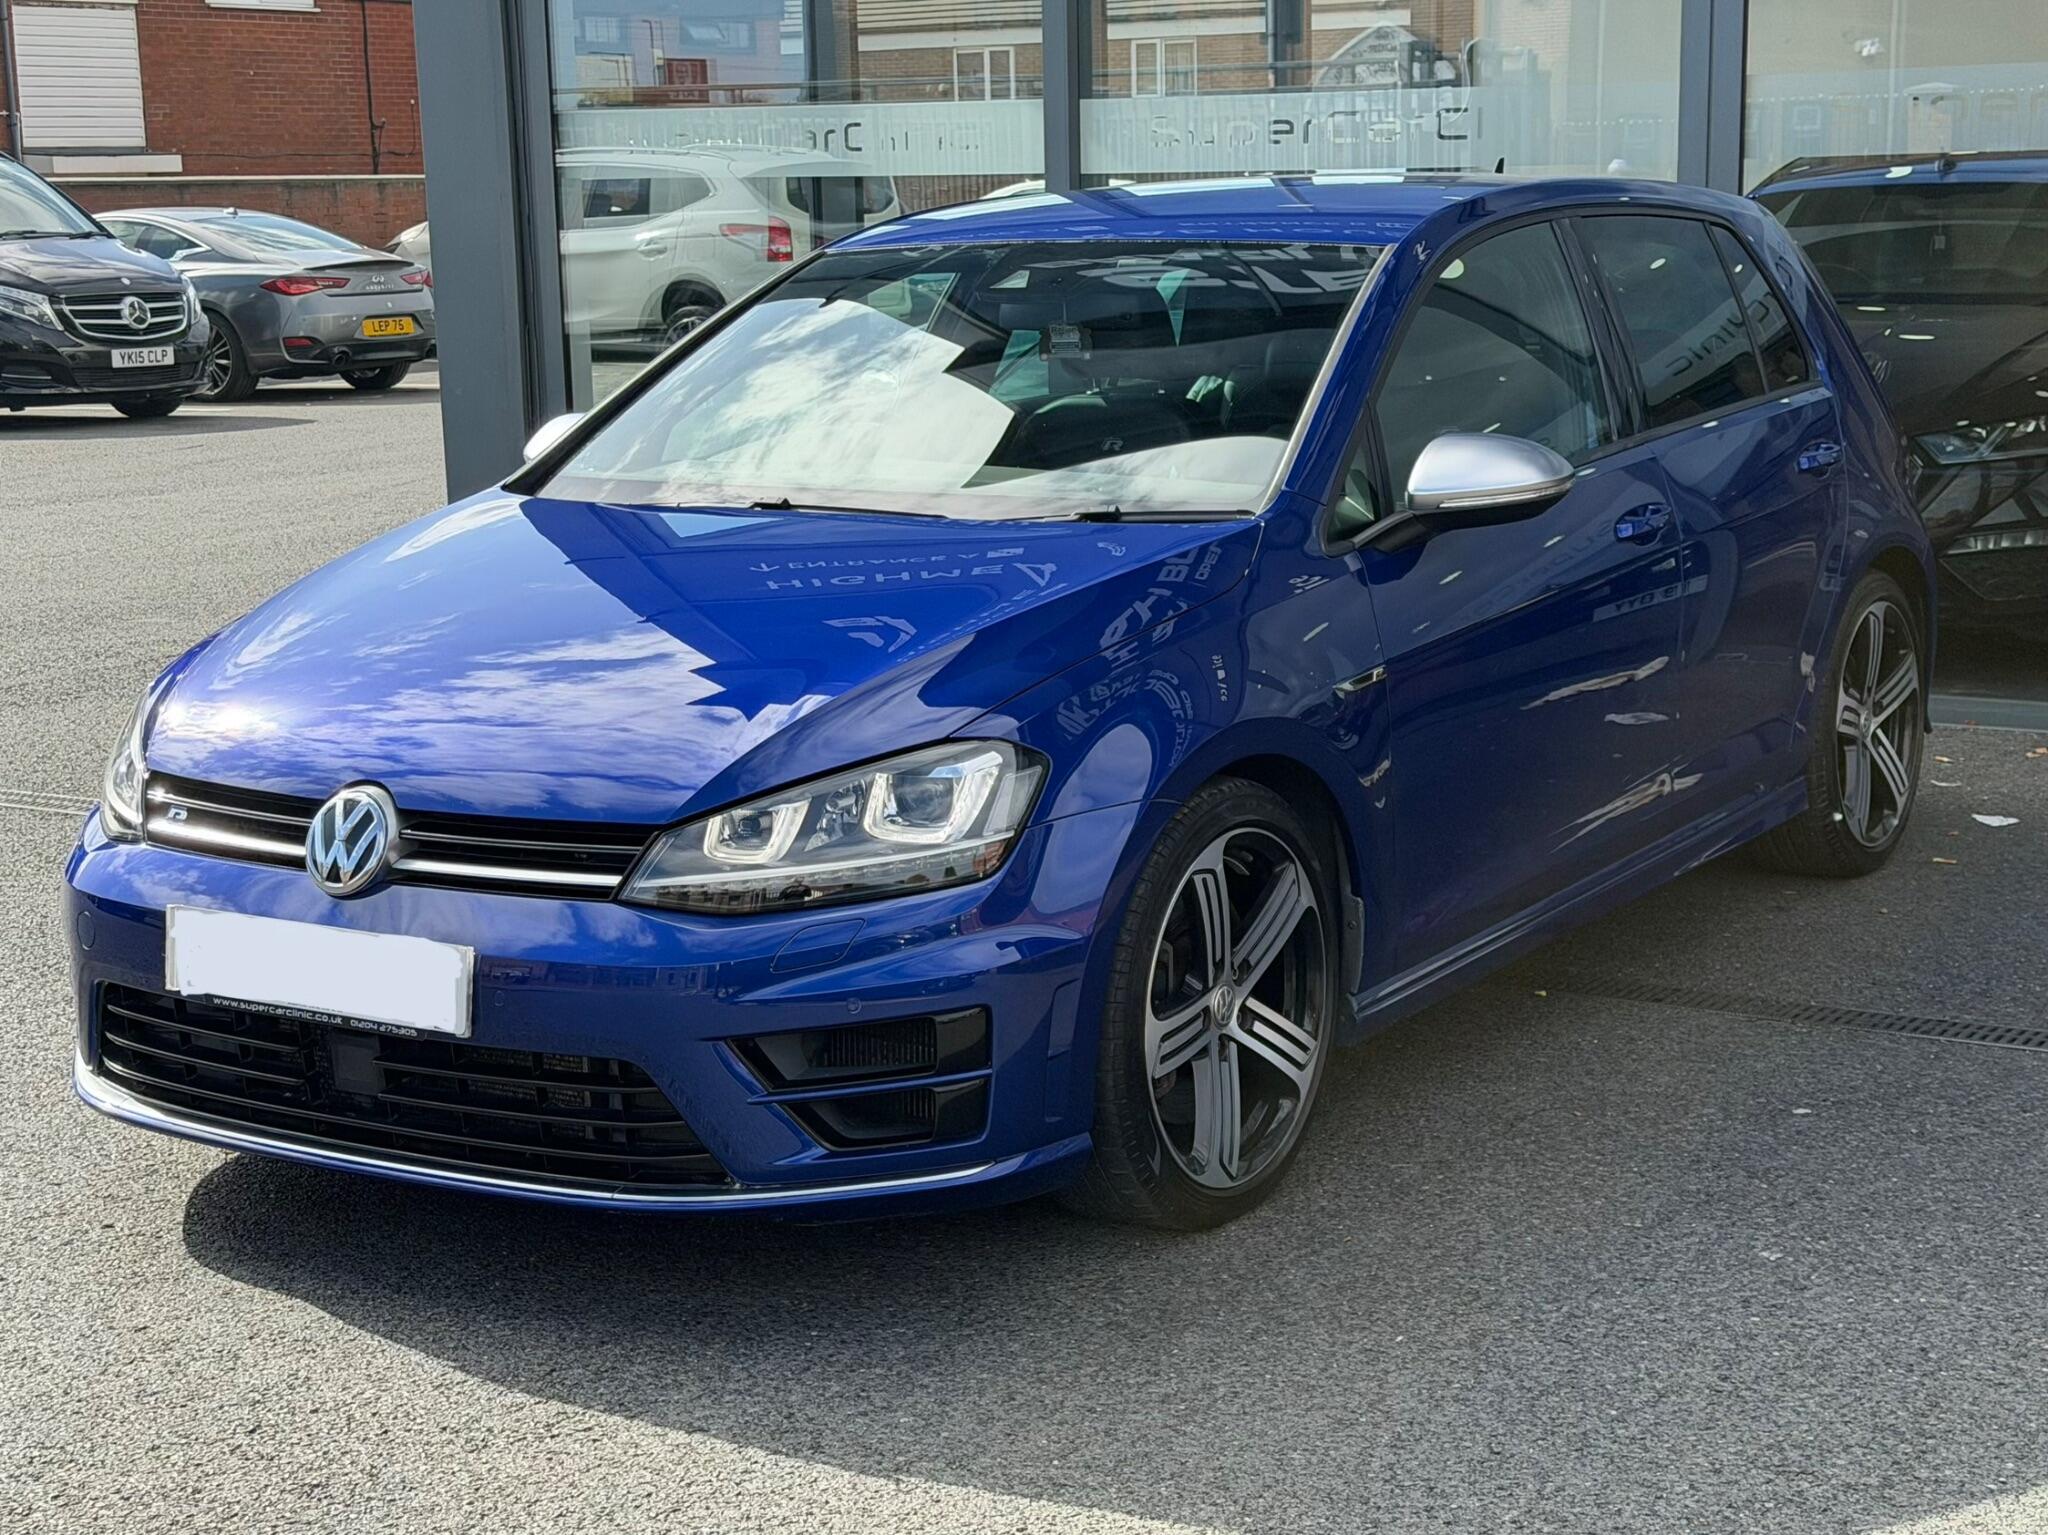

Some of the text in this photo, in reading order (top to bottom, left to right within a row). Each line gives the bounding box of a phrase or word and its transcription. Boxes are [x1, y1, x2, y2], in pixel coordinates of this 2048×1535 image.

[371, 319, 405, 333] LEP 75
[119, 349, 168, 365] YK15 CLP
[213, 997, 343, 1025] www.supercarclinic.co.uk
